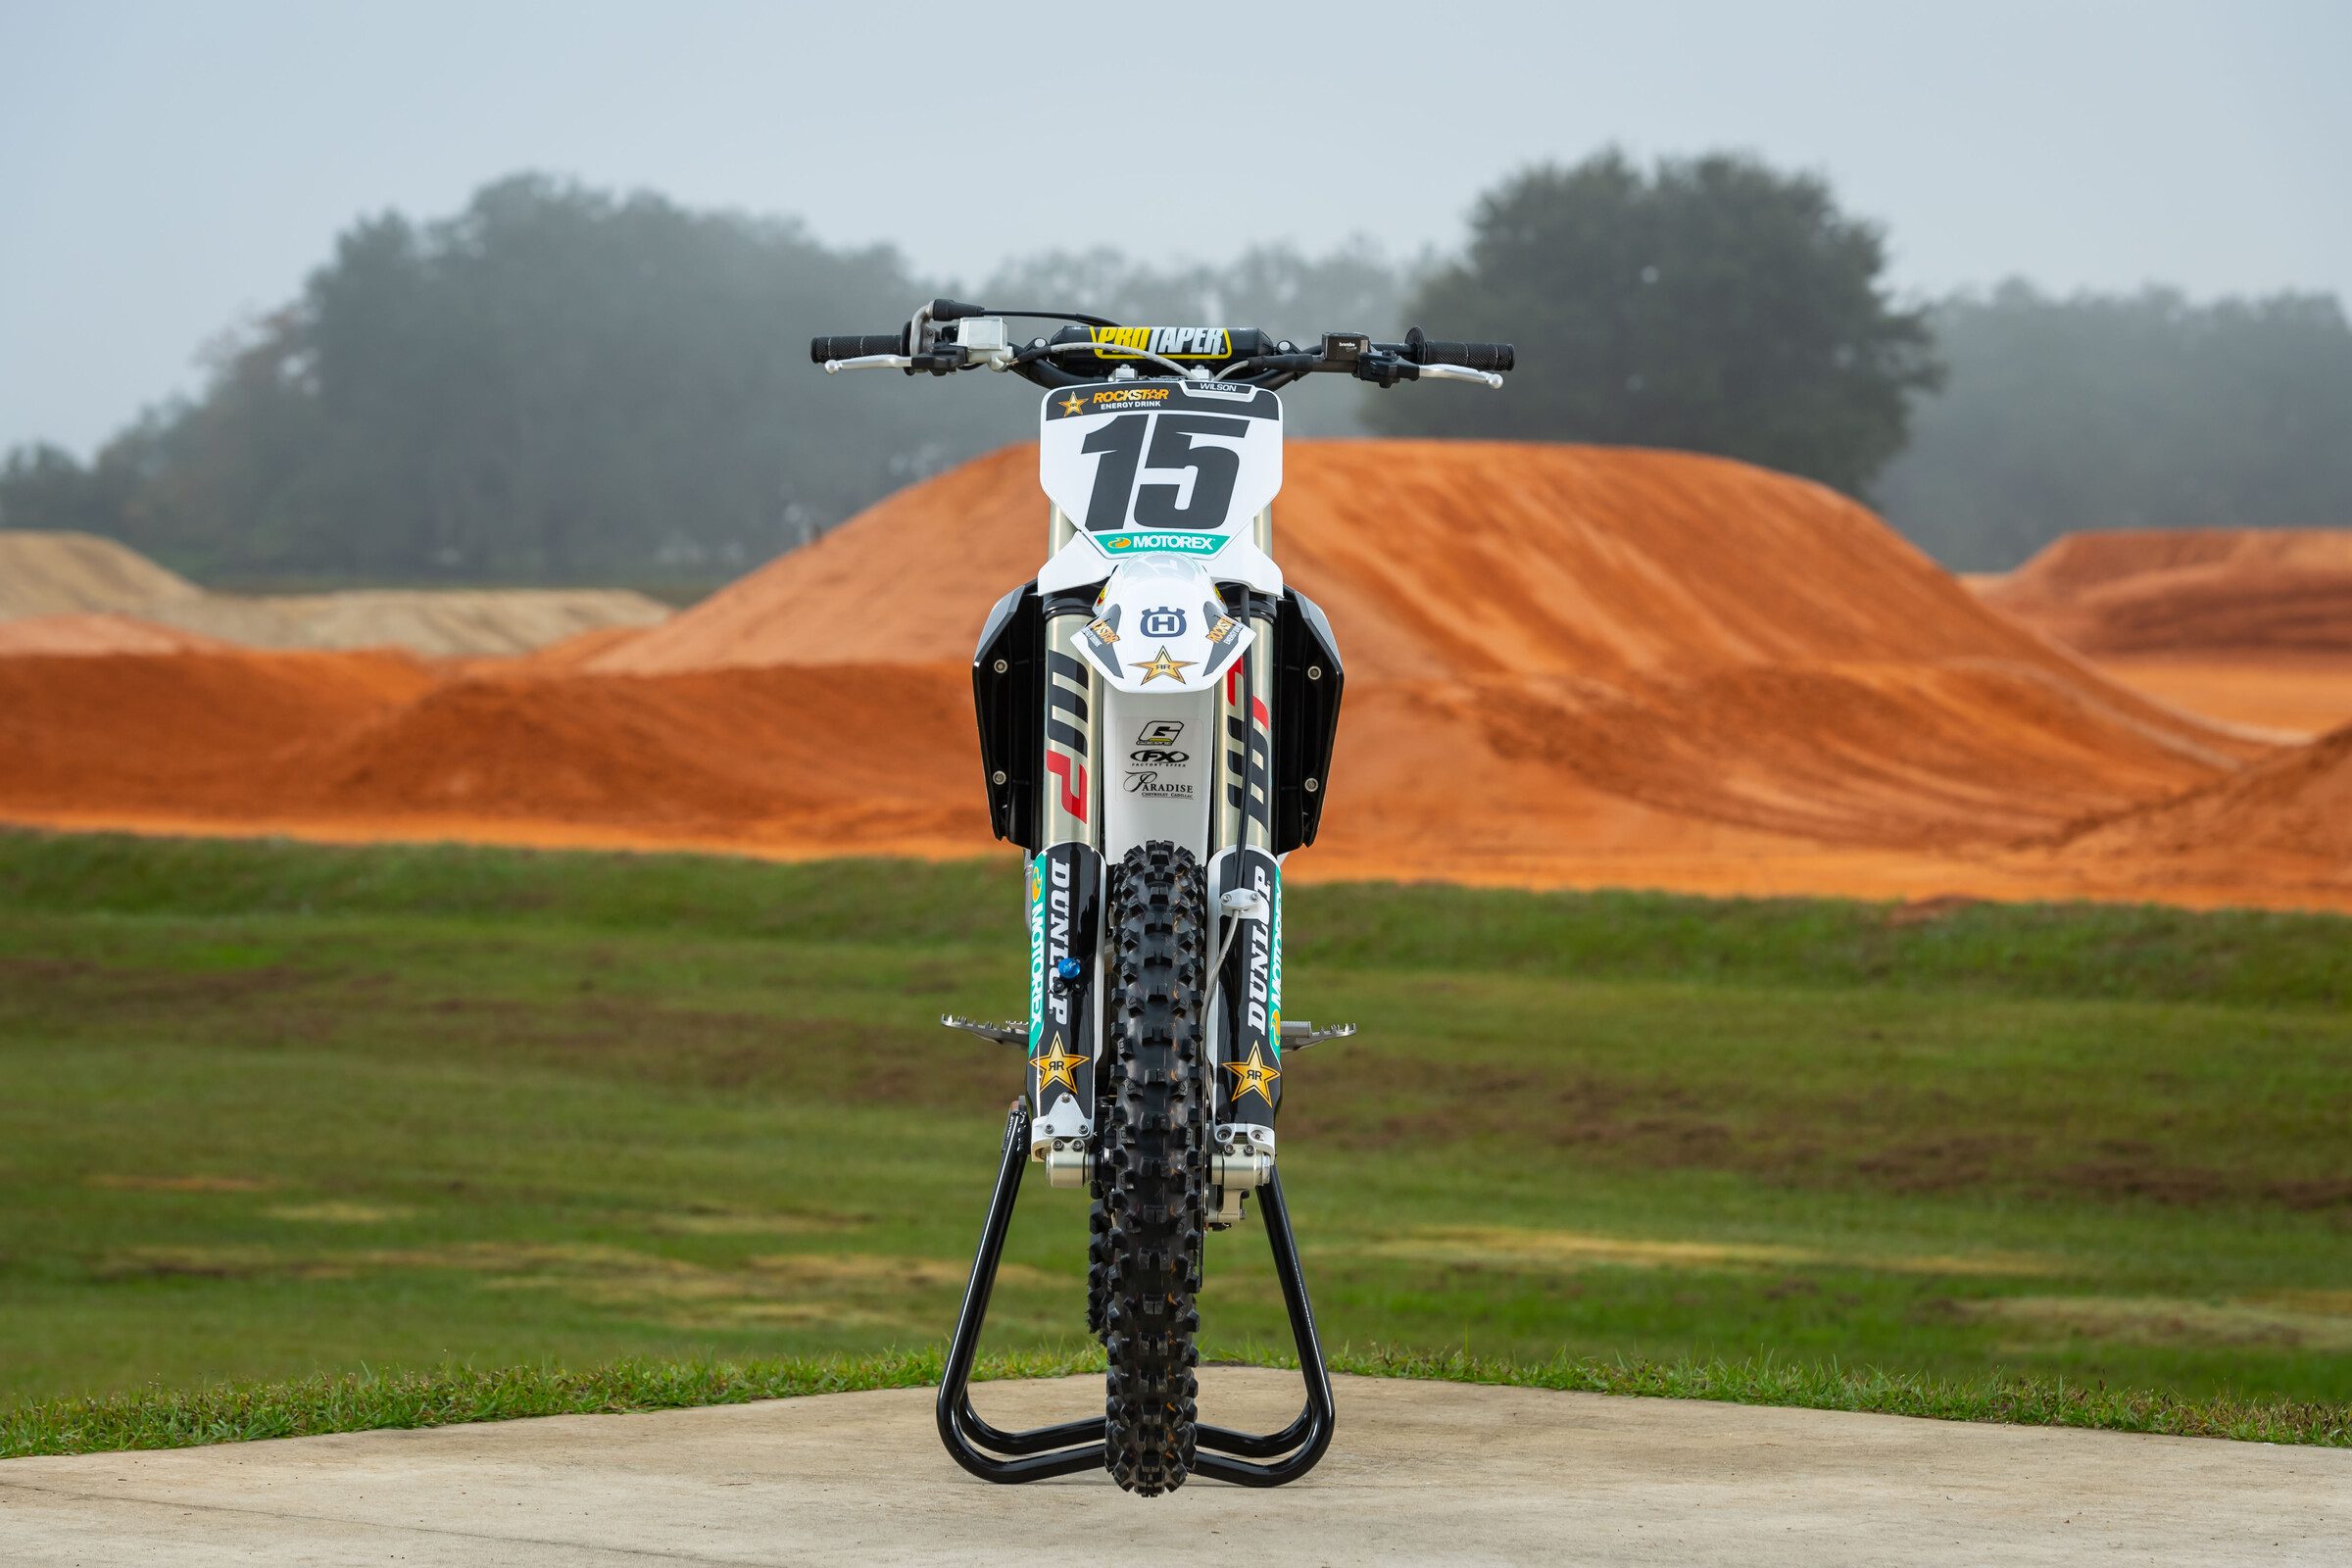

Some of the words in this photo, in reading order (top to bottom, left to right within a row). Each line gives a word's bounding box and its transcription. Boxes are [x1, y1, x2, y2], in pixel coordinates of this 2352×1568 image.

[1098, 326, 1225, 355] PROTAPER
[1093, 389, 1169, 404] ROCKSTAR
[1200, 381, 1237, 392] WILSON
[1101, 401, 1134, 411] ENERGY
[1134, 400, 1161, 409] DRINK
[1080, 413, 1250, 532] 15
[1133, 535, 1213, 551] MOTOREX
[1206, 617, 1233, 644] ROCKST
[1030, 902, 1044, 1032] MOTOREX
